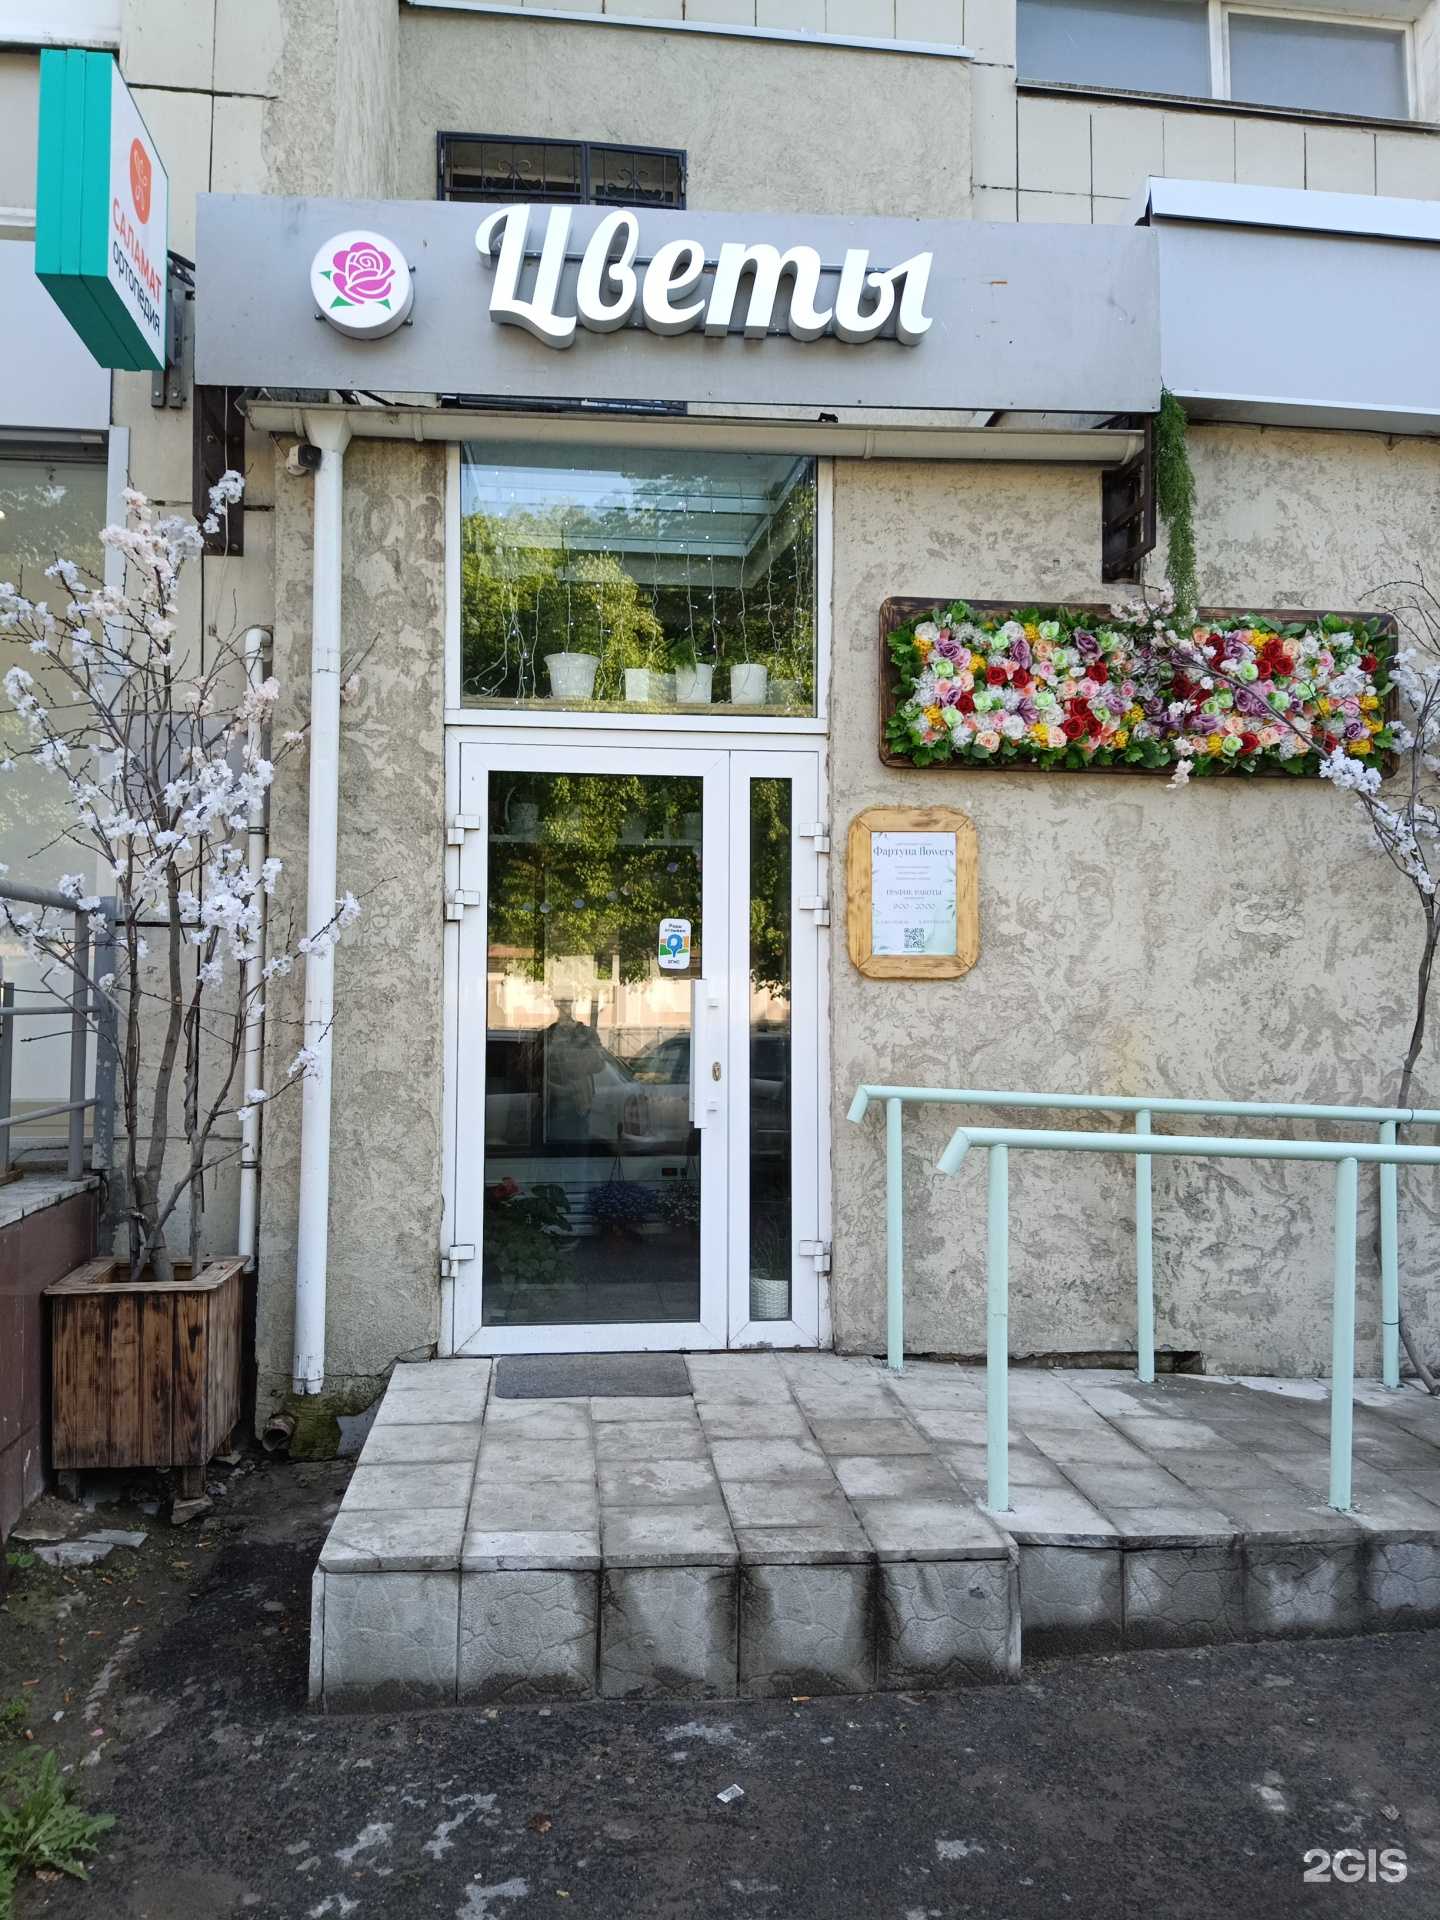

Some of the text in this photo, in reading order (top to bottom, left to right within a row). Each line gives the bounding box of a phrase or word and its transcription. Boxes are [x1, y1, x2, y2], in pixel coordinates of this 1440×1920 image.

[112, 197, 162, 304] САЛАМАТ
[112, 240, 161, 337] ортопедия
[475, 203, 934, 346] Цветы
